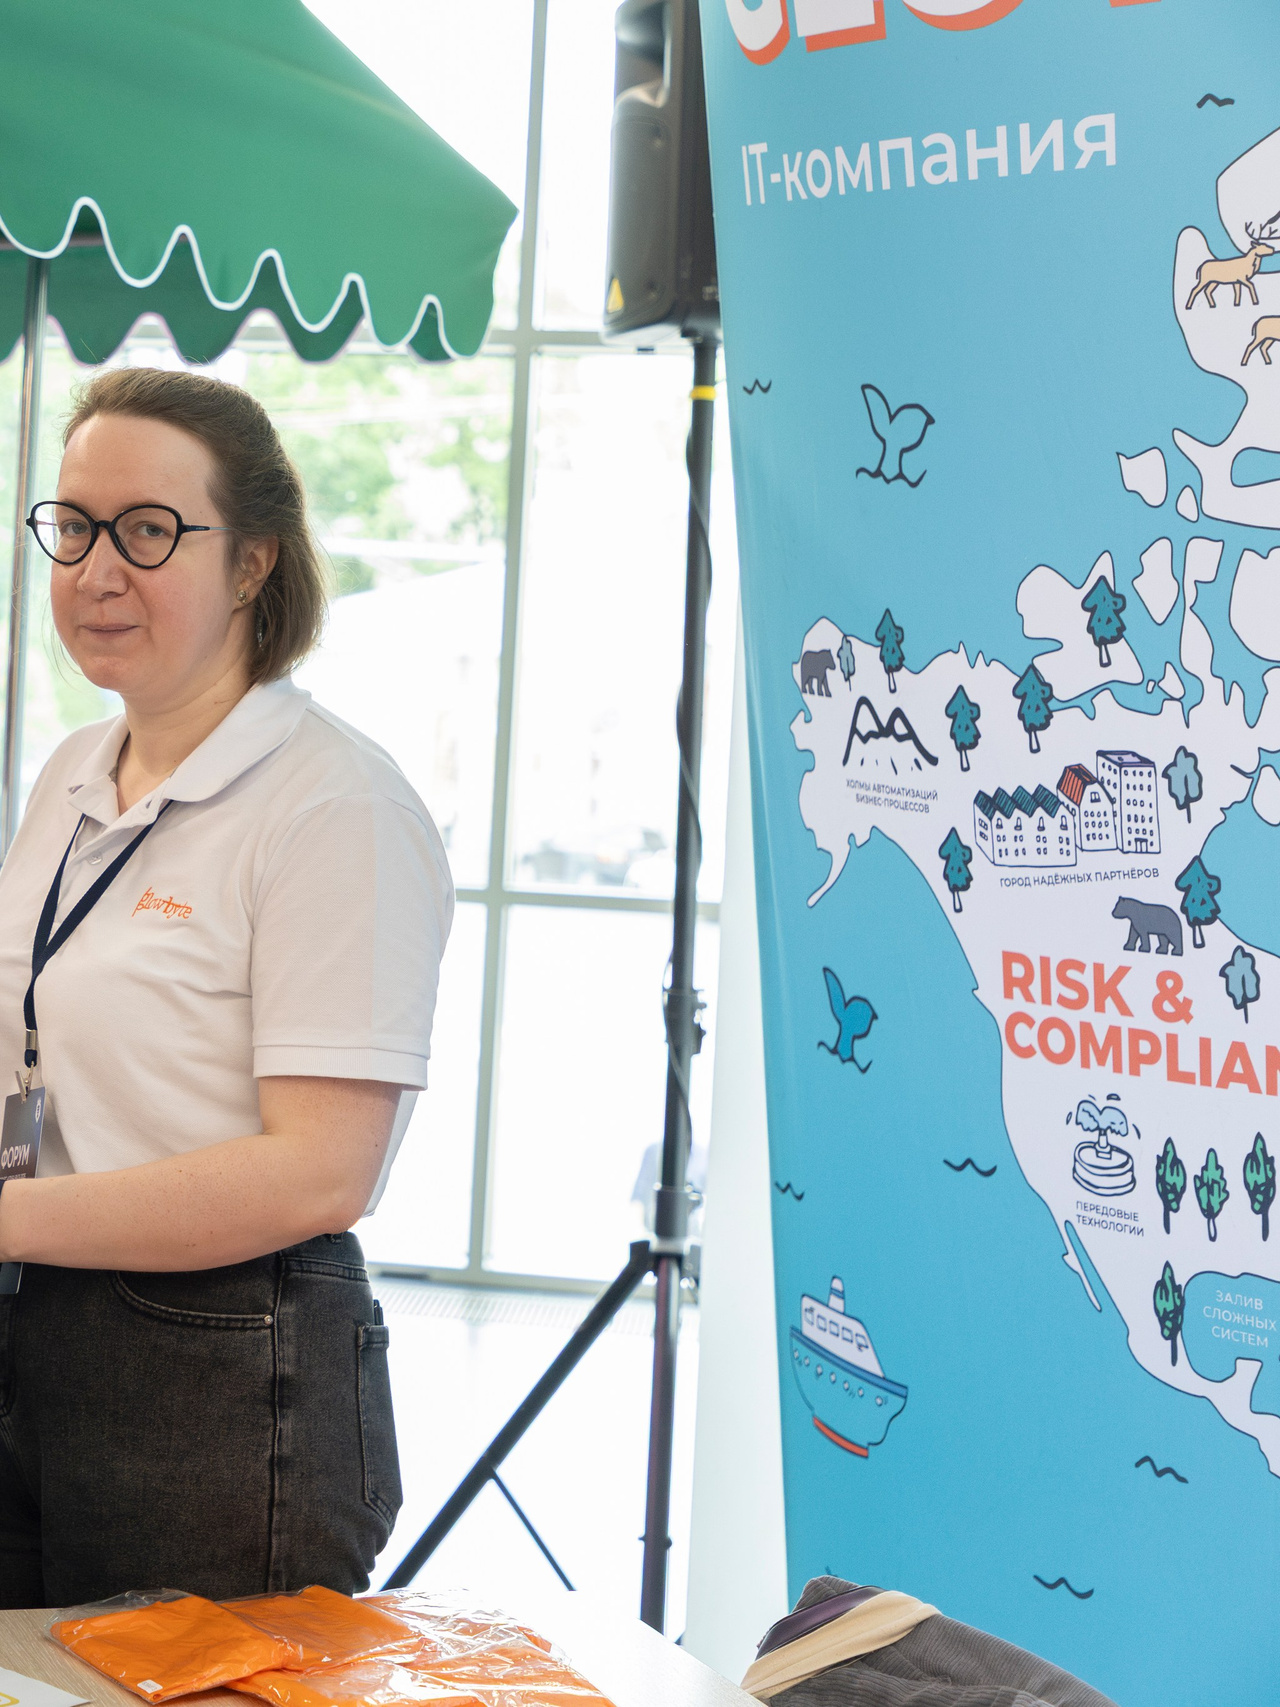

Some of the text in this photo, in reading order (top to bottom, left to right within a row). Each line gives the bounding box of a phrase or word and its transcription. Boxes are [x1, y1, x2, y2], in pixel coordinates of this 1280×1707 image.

[741, 112, 1117, 206] IT-компания
[846, 779, 938, 801] ХОЛМЫ АВТОМАТИЗАЦИЙ
[856, 793, 930, 813] БИЗНЕС-ПРОЦЕССОВ
[1000, 867, 1159, 888] ГОРОД НАДЁЖНЫХ ПАРТНЁРОВ
[132, 886, 192, 919] glowbyte
[1002, 950, 1194, 1024] RISK &
[1, 1143, 31, 1169] ФОРУМ
[1076, 1201, 1139, 1222] ПЕРЕДОВЫЕ
[1076, 1214, 1144, 1237] ТЕХНОЛОГИИ
[1216, 1290, 1263, 1310] ЗАЛИВ
[1203, 1306, 1277, 1331] СЛОЖНЫХ
[1212, 1326, 1269, 1348] СИСТЕМ
